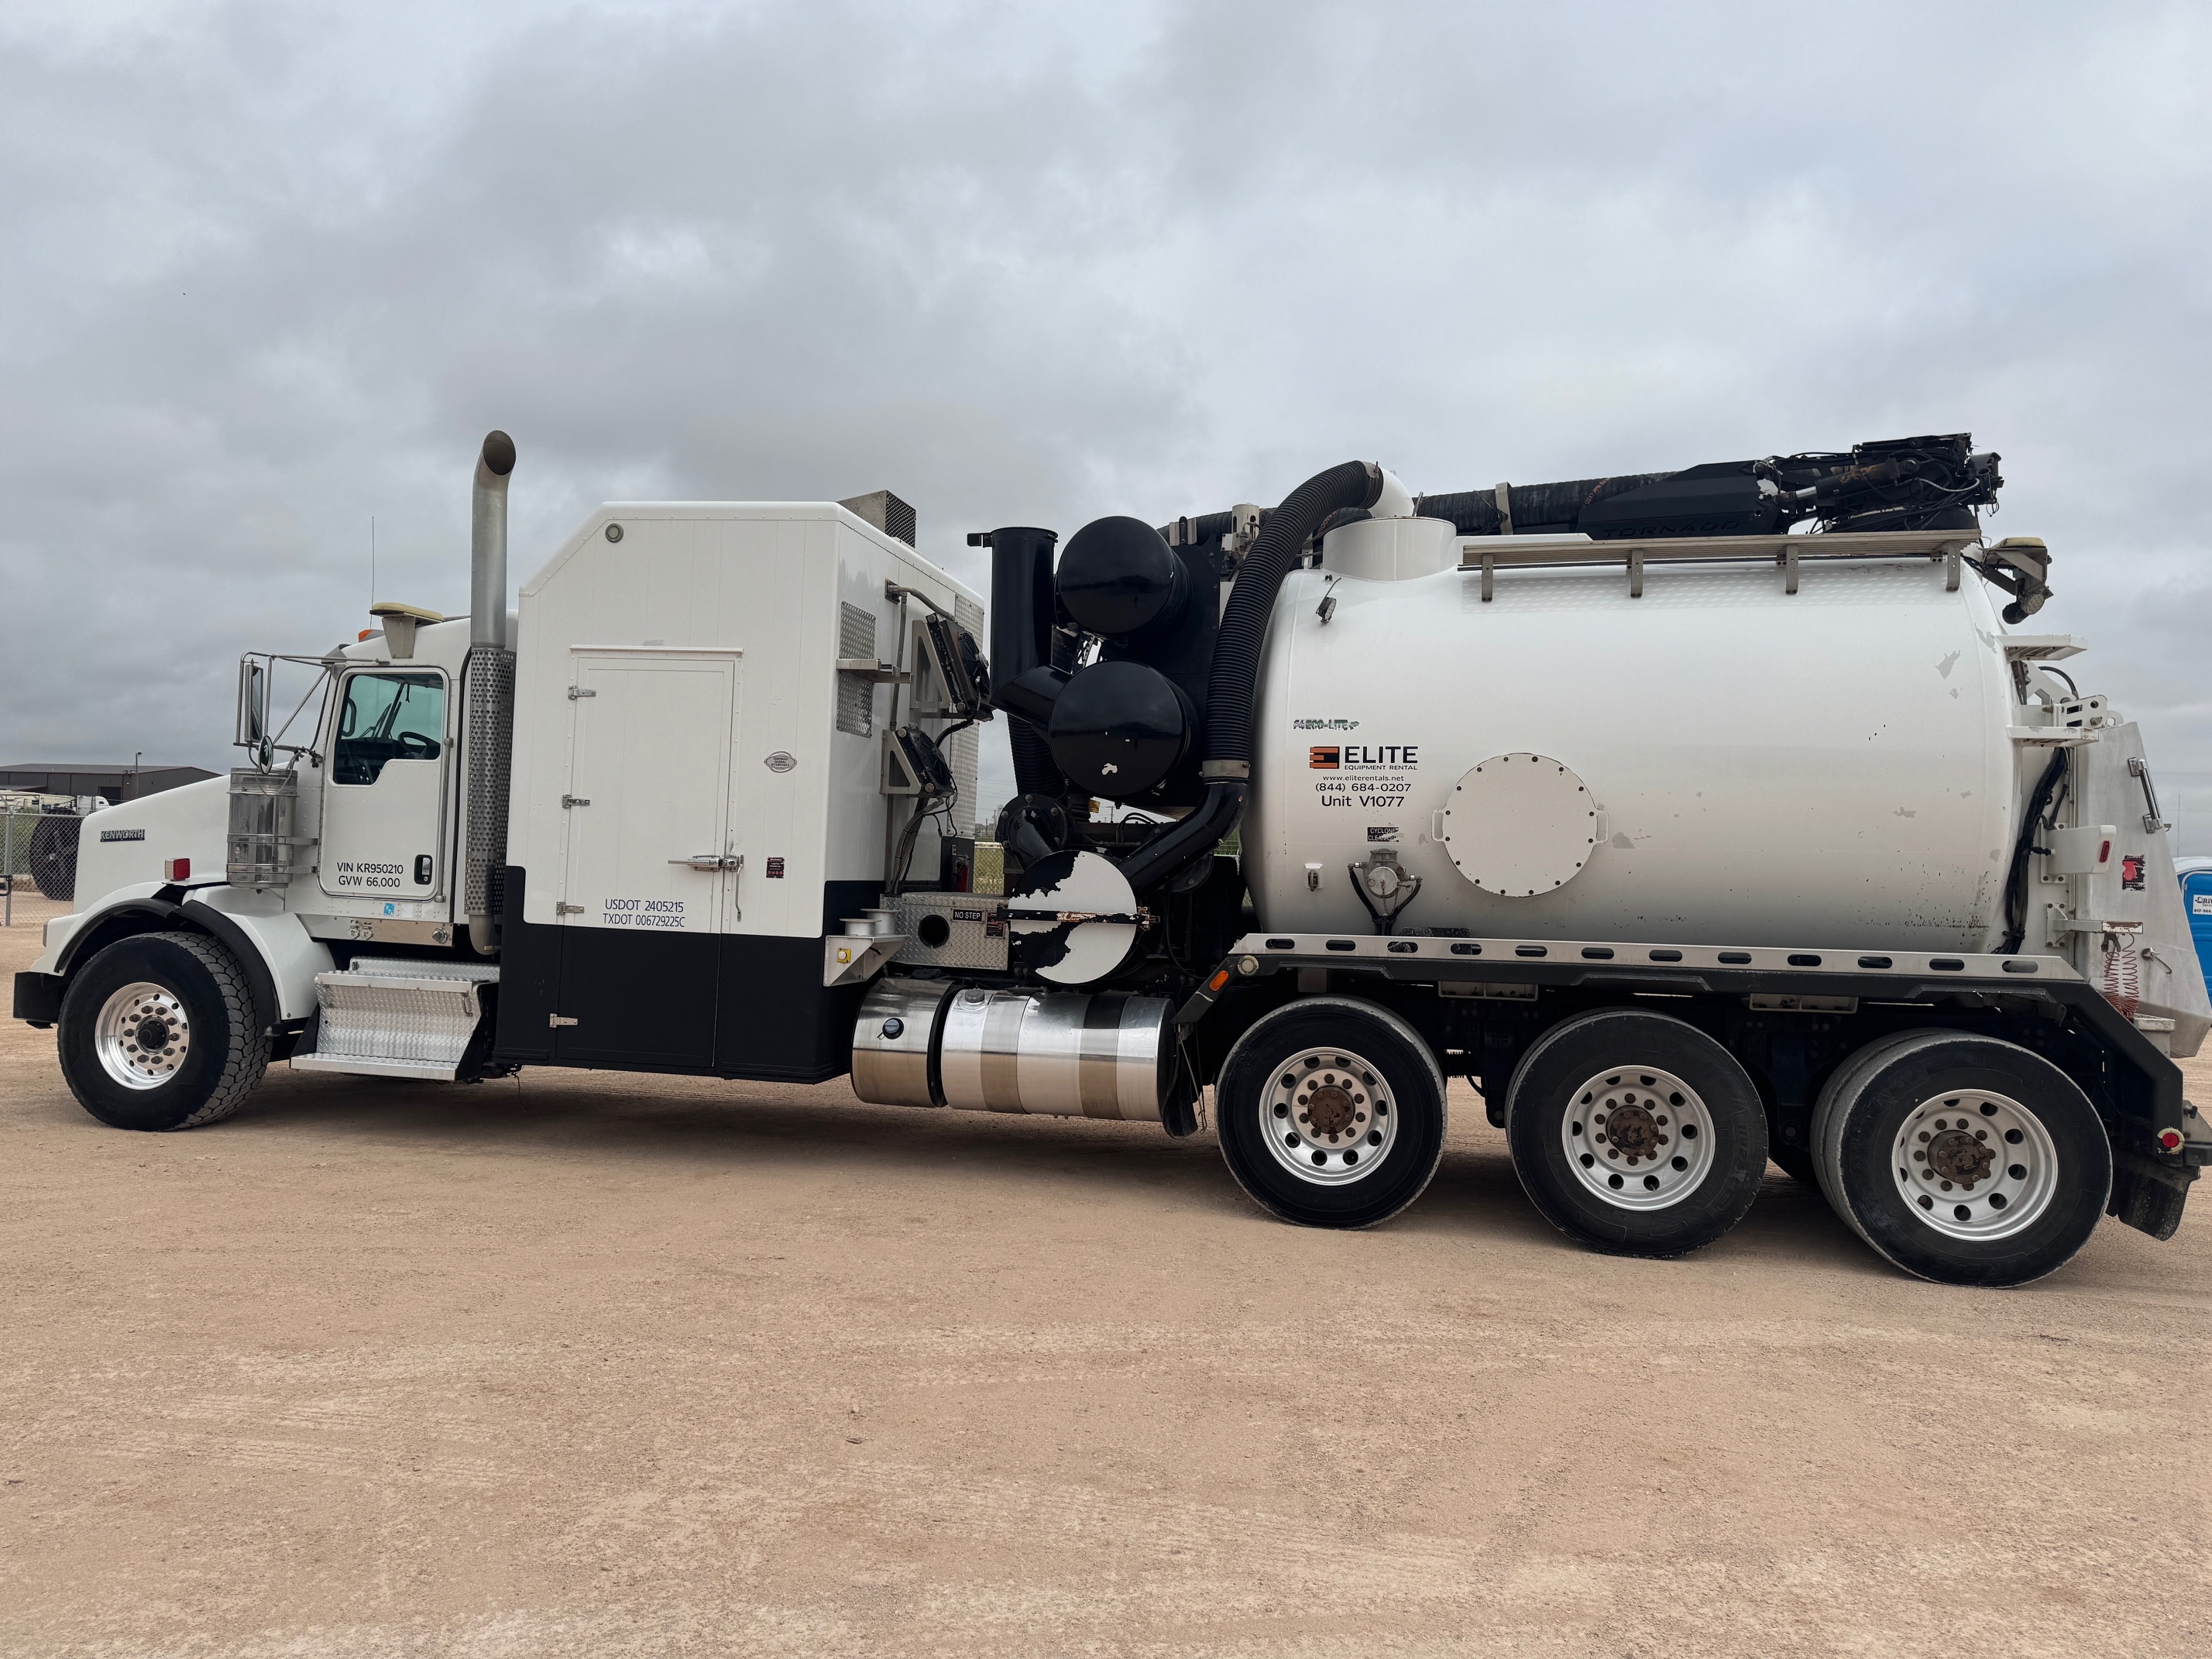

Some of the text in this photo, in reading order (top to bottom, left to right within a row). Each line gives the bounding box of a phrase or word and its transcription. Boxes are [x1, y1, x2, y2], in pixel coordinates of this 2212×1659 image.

[1603, 520, 1740, 538] TORNADO
[1345, 746, 1418, 764] ELITE
[1315, 783, 1412, 792] (844) 684-0207
[1321, 795, 1405, 807] Unit V1077
[101, 829, 145, 840] KENWORTH
[337, 862, 404, 874] VIN KR950210
[338, 875, 400, 888] GVW 66,000
[605, 898, 684, 913] USDOT 2405215
[603, 912, 685, 928] TXDOT 006729225C
